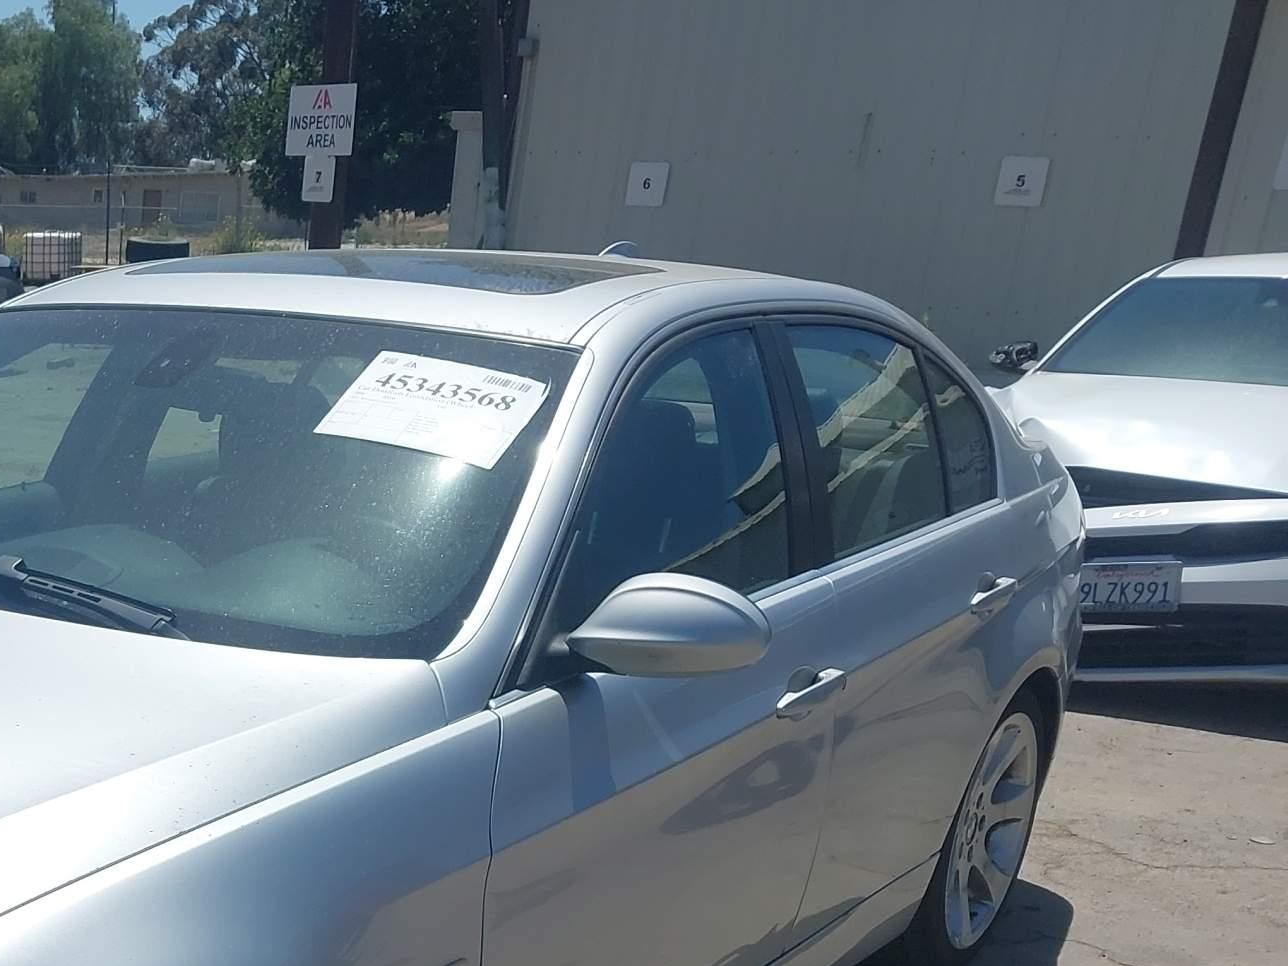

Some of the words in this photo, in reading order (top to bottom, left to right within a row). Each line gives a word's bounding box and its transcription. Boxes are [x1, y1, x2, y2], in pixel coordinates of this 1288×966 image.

[290, 114, 352, 130] INSPECTION
[306, 133, 336, 148] AREA
[315, 171, 322, 183] 7
[643, 177, 651, 190] 6
[1016, 174, 1026, 188] 5
[375, 372, 518, 412] 45343568
[1079, 581, 1171, 604] 9LZK991
